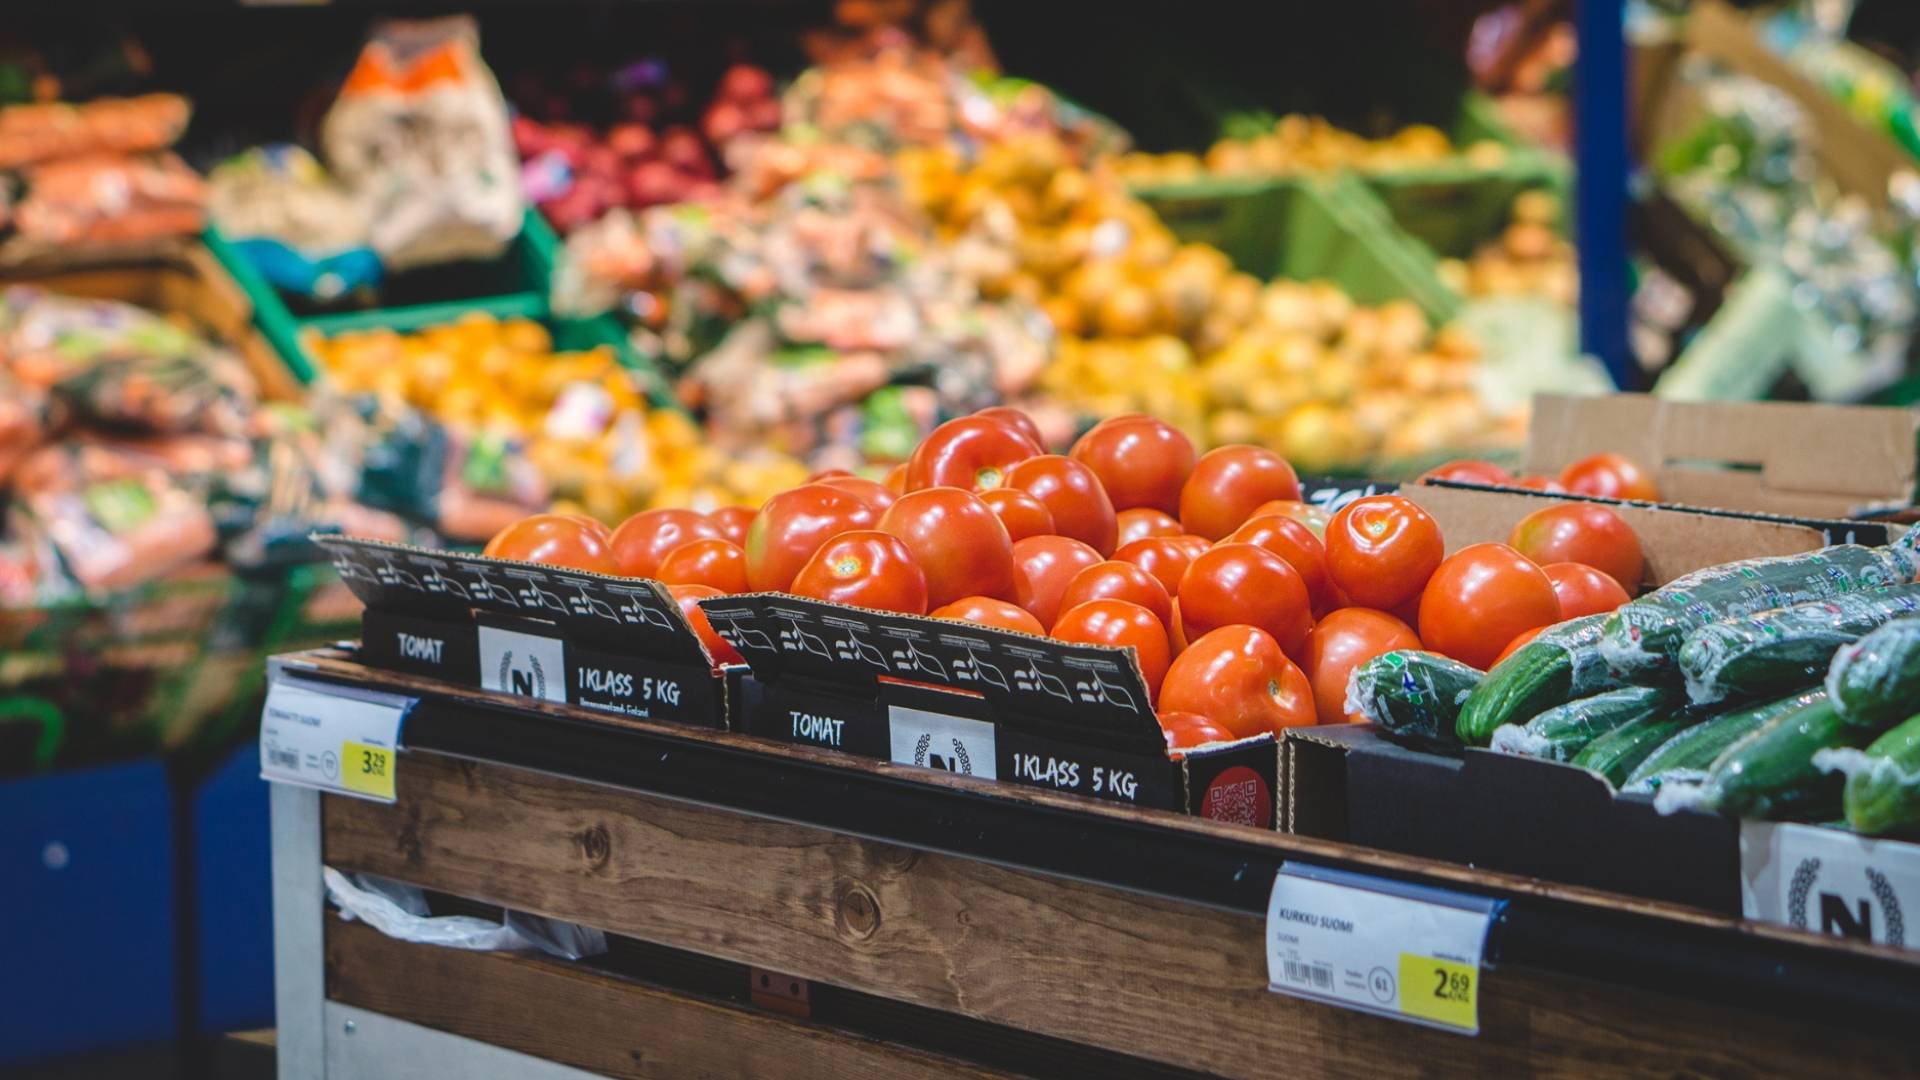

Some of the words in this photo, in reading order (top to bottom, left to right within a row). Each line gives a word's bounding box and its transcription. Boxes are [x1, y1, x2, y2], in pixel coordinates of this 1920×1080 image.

[397, 632, 445, 664] TOMAT
[512, 669, 532, 695] N
[586, 667, 633, 697] KLASS
[642, 677, 653, 700] 5
[656, 678, 681, 706] KG
[790, 711, 844, 746] TOMAT
[1023, 755, 1080, 787] KLASS
[1092, 766, 1105, 792] 5
[1110, 768, 1138, 799] KG
[1279, 908, 1318, 927] KURKKU
[1320, 915, 1354, 933] SUOMI
[1819, 891, 1873, 944] N
